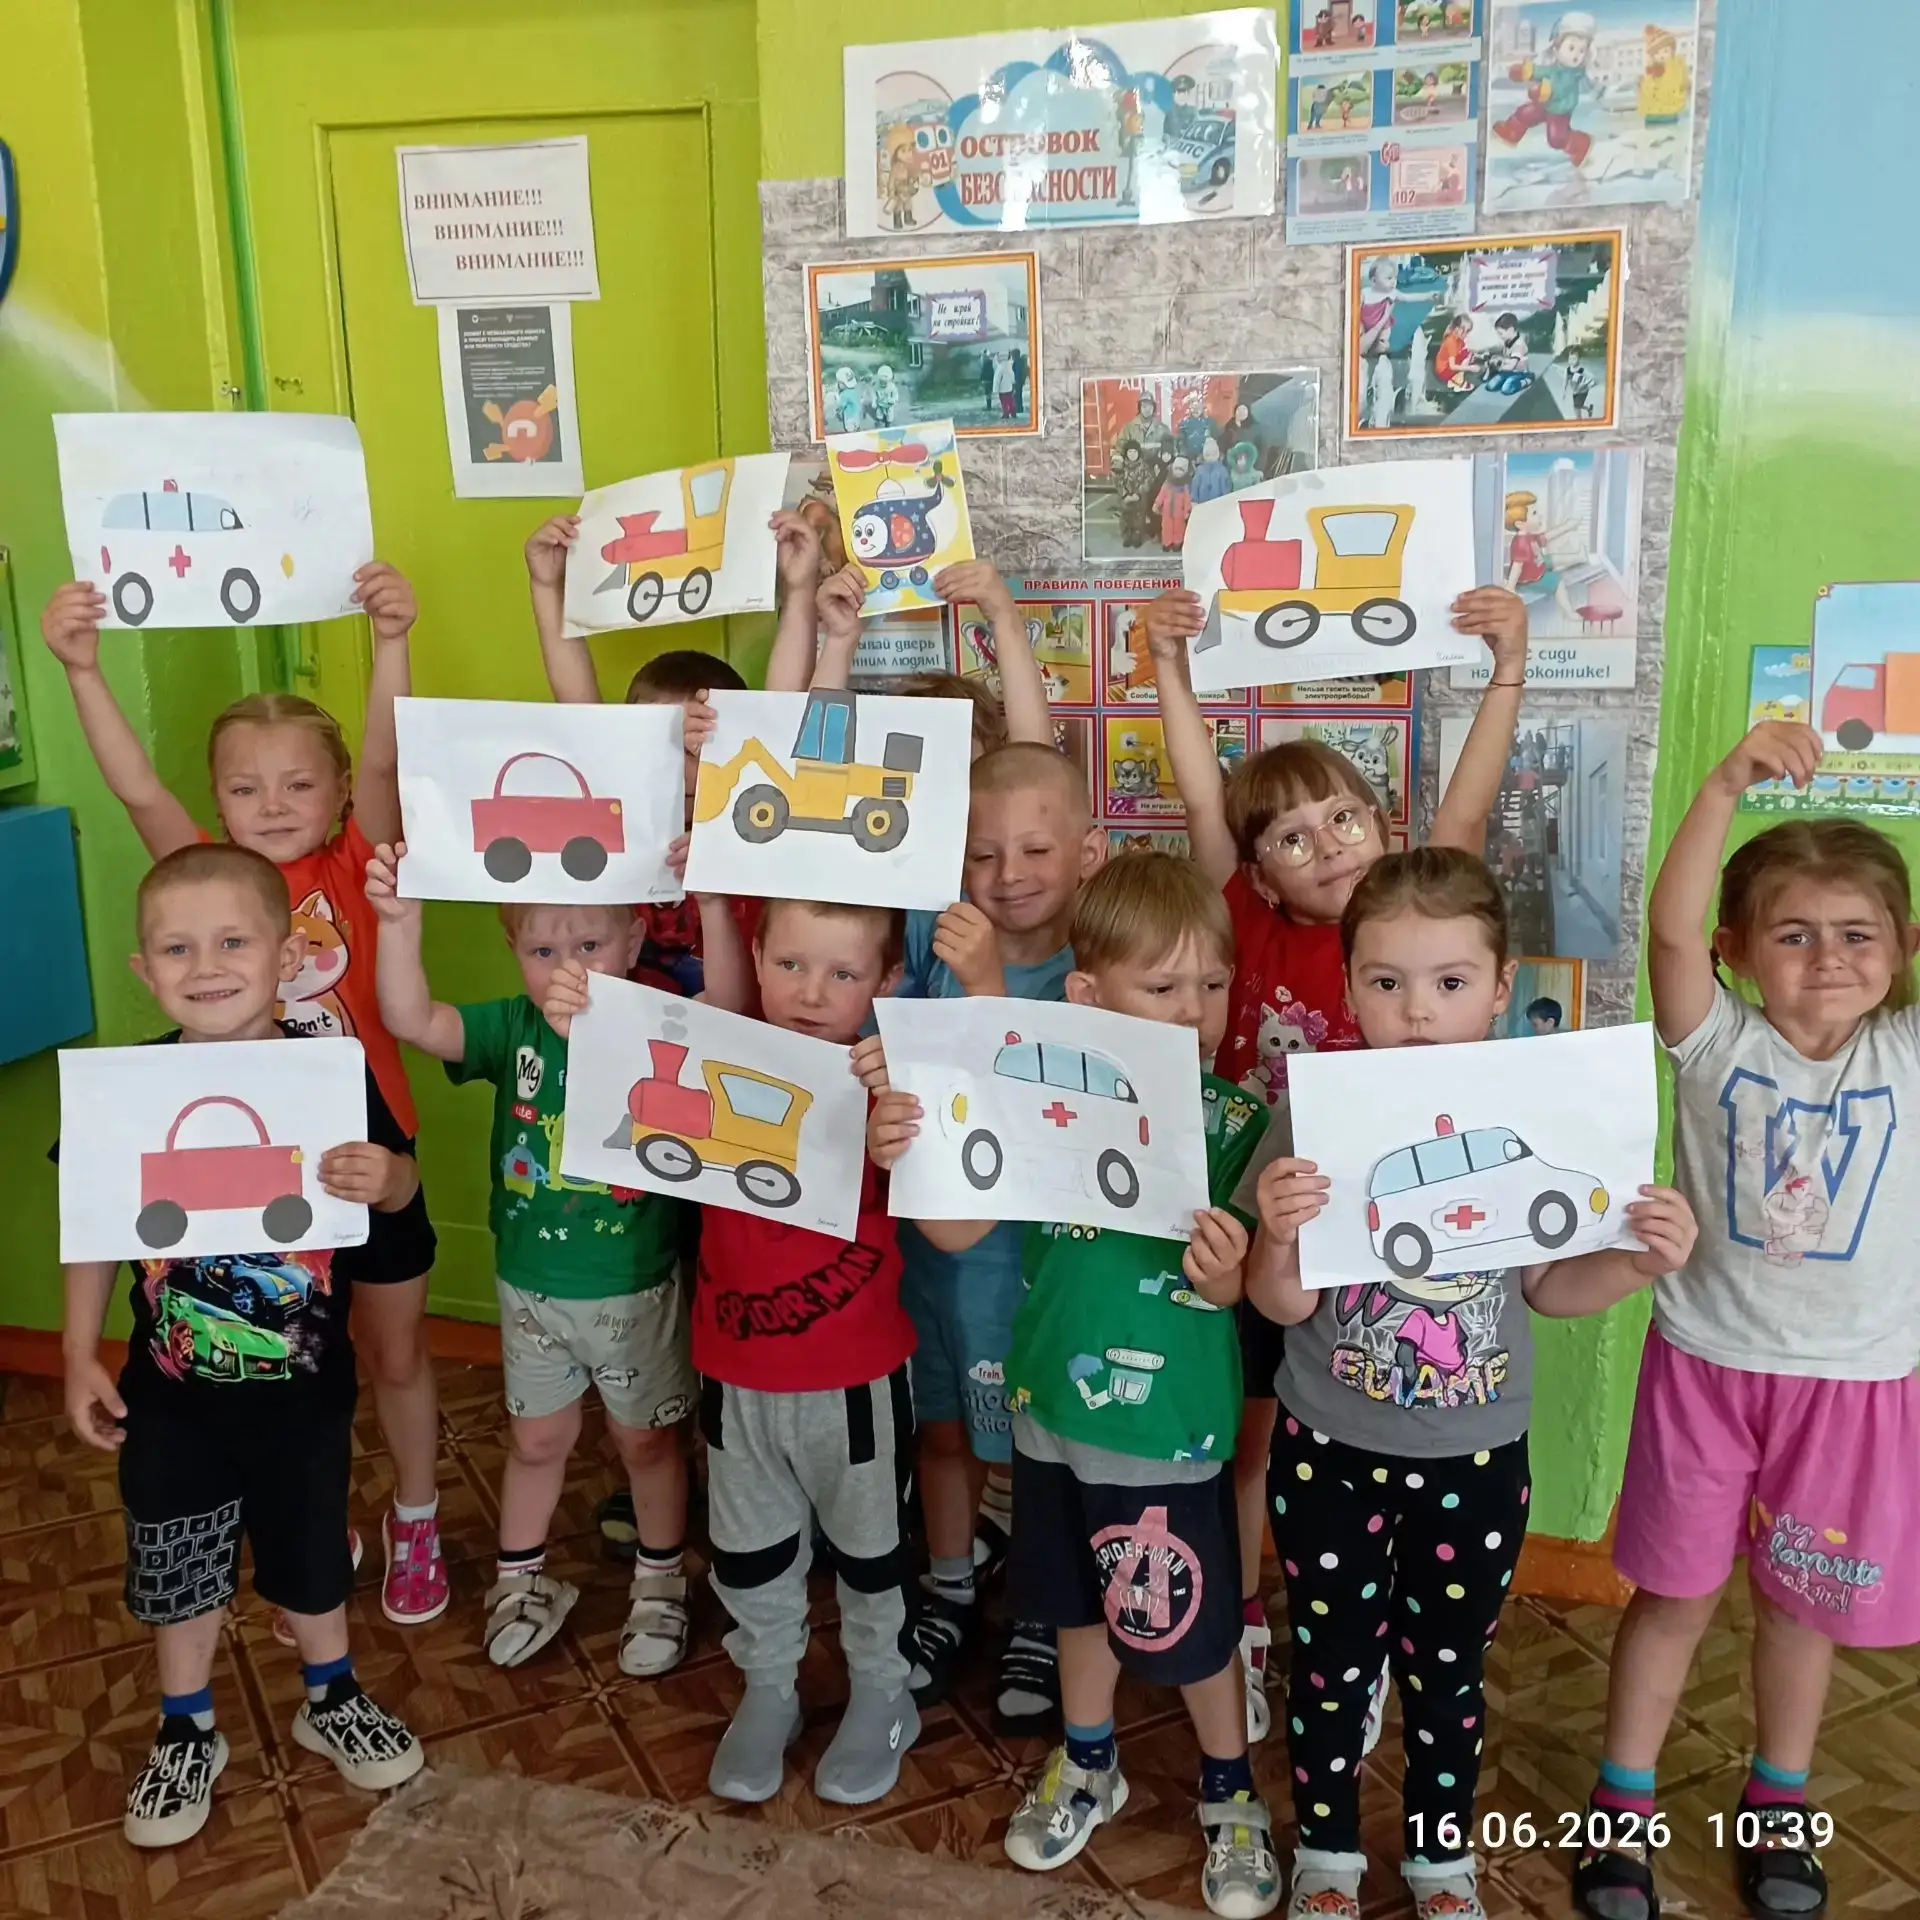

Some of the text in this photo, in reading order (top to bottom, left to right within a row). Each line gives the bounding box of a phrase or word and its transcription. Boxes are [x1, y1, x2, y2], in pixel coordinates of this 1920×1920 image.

[960, 165, 1118, 206] БЕЗОСНОСТИ
[413, 189, 542, 210] ВНИМАНИЕ!!!
[435, 220, 564, 240] ВНИМАНИЕ!!!
[456, 250, 585, 271] ВНИМАНИЕ!!!
[1024, 578, 1181, 591] ПРАВИЛА ПОВЕДЕНИЯ
[858, 638, 936, 653] ывай дверь
[892, 655, 940, 669] людям!
[1539, 648, 1577, 663] сиди
[1471, 665, 1610, 679] на оконнике!
[518, 1054, 541, 1092] My
[978, 1367, 1001, 1379] Train
[1096, 1540, 1187, 1576] SPIDER-MAN
